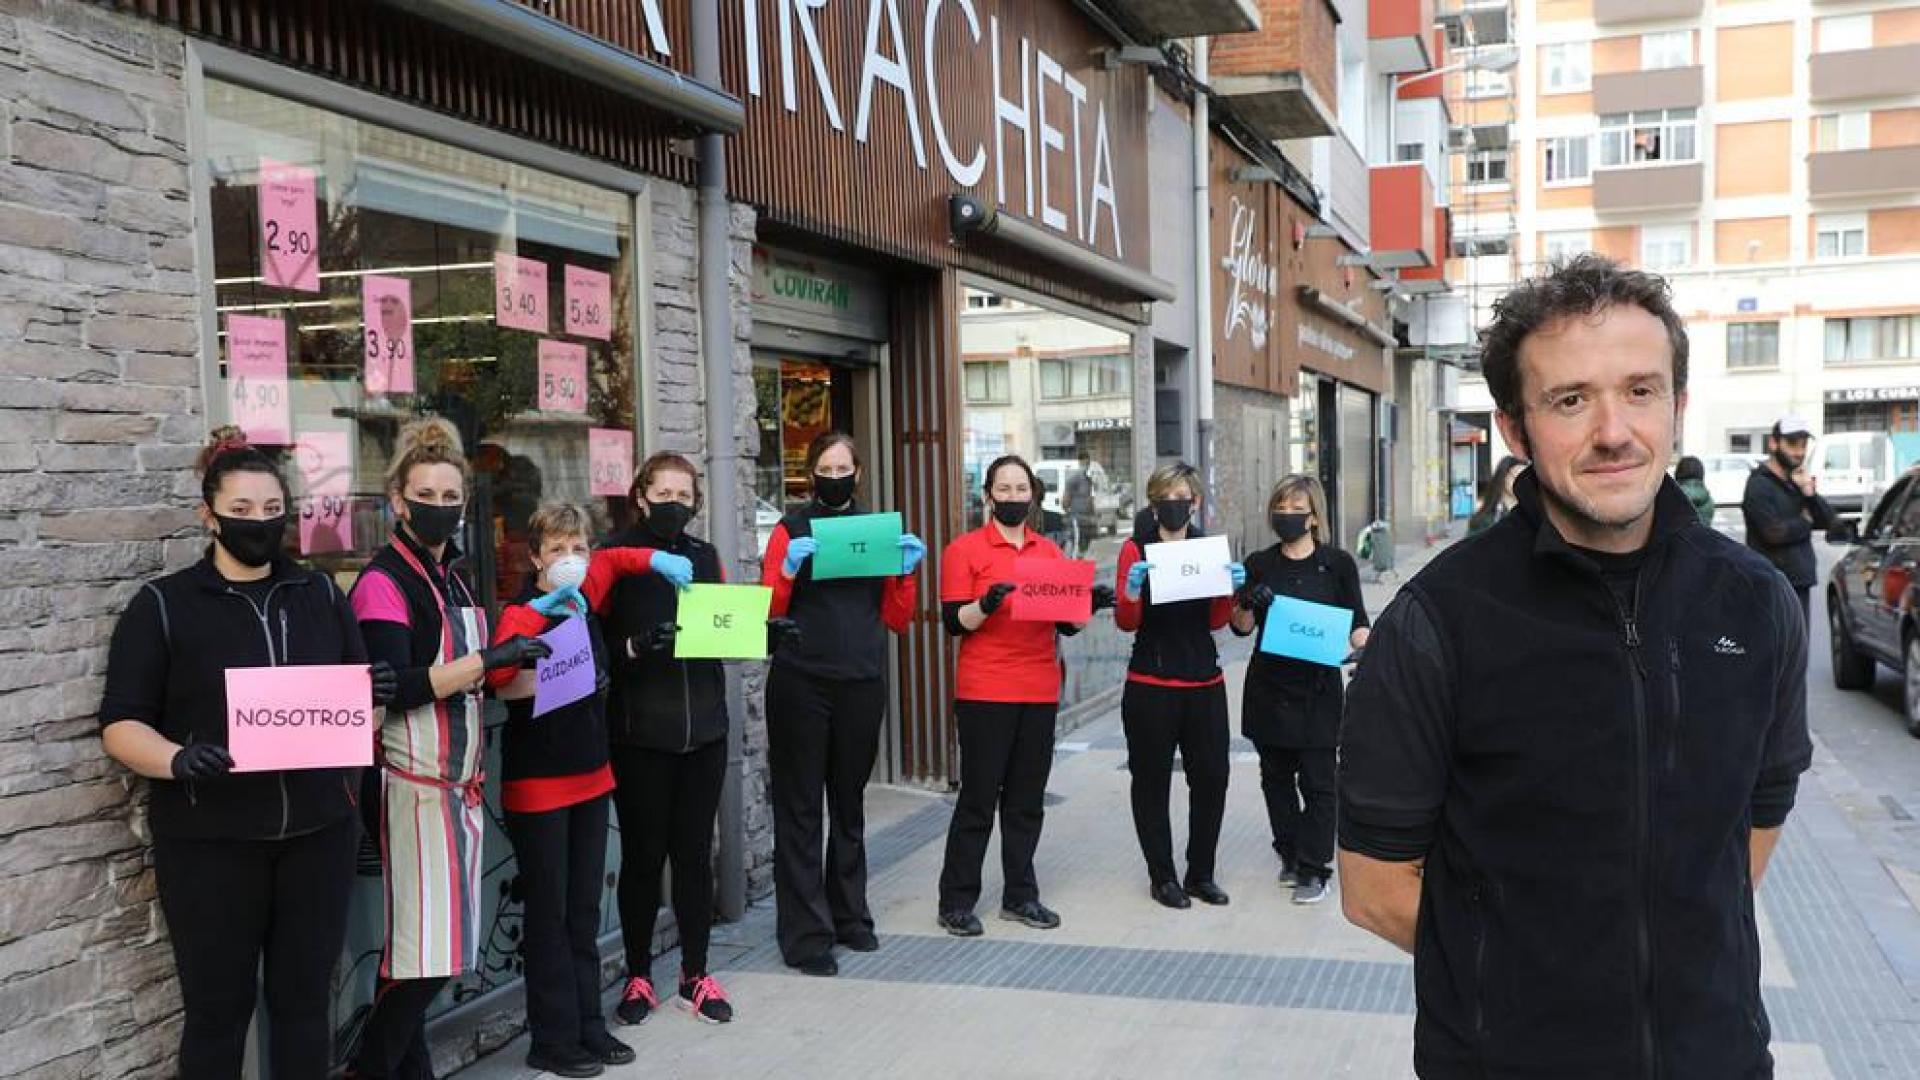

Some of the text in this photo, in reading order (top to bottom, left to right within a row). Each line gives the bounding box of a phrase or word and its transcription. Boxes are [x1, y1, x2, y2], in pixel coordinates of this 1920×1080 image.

[850, 541, 867, 554] TI
[1180, 561, 1201, 577] EN
[1022, 582, 1083, 597] QUEDATE
[712, 613, 733, 629] DE
[1289, 621, 1326, 640] CASA
[235, 708, 366, 728] NOSOTROS
